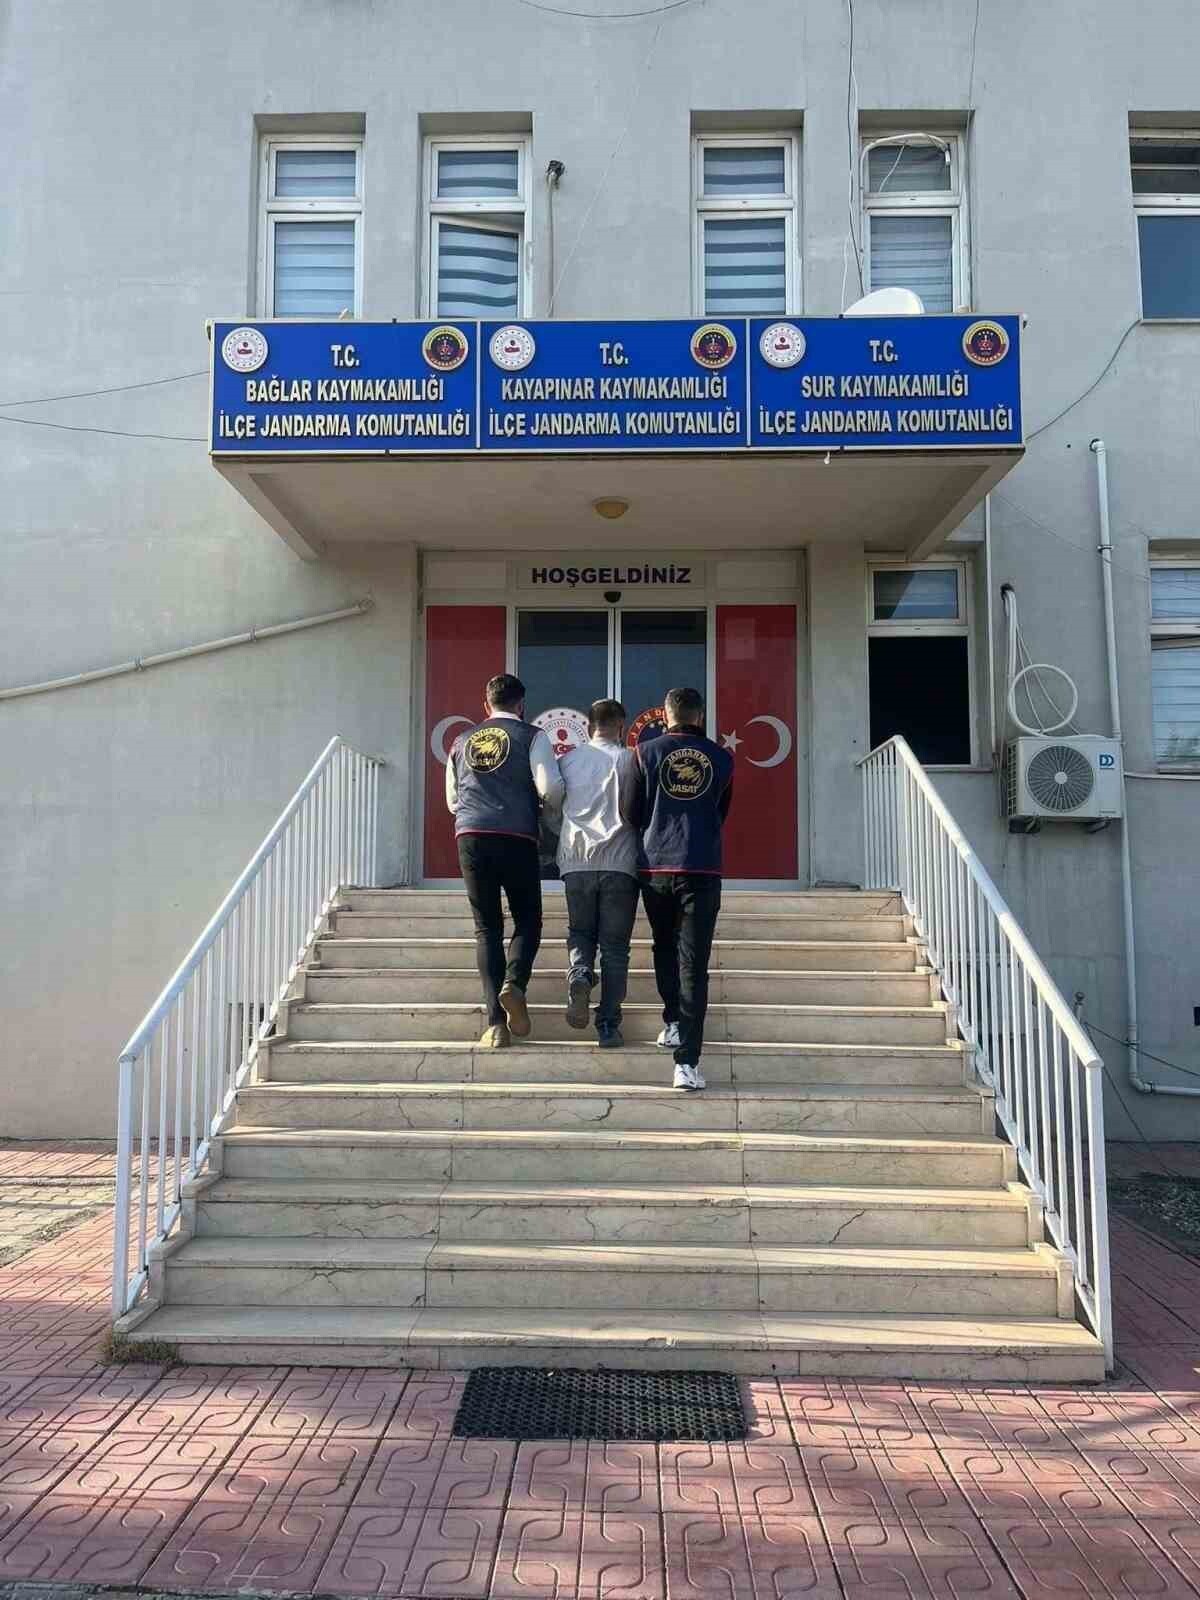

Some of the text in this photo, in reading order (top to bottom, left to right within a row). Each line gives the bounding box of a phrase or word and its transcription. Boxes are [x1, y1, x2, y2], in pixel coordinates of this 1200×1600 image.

[331, 345, 360, 366] T.C.
[600, 343, 628, 365] T.C.
[869, 340, 898, 362] T.C.
[246, 374, 443, 402] BAĞLAR KAYMAKAMLIĞI
[502, 372, 726, 400] KAYAPINAR KAYMAKAMLIĞI
[802, 371, 968, 398] SUR KAYMAKAMLIĞI
[219, 409, 470, 438] İLÇE JANDARMA KOMUTANLIĞI
[489, 407, 740, 437] İLÇE JANDARMA KOMUTANLIĞI
[760, 405, 1012, 435] İLÇE JANDARMA KOMUTANLIĞI
[531, 564, 691, 588] HOŞGELDİNİZ
[668, 749, 709, 769] JANDARMA
[670, 783, 700, 793] JASAT
